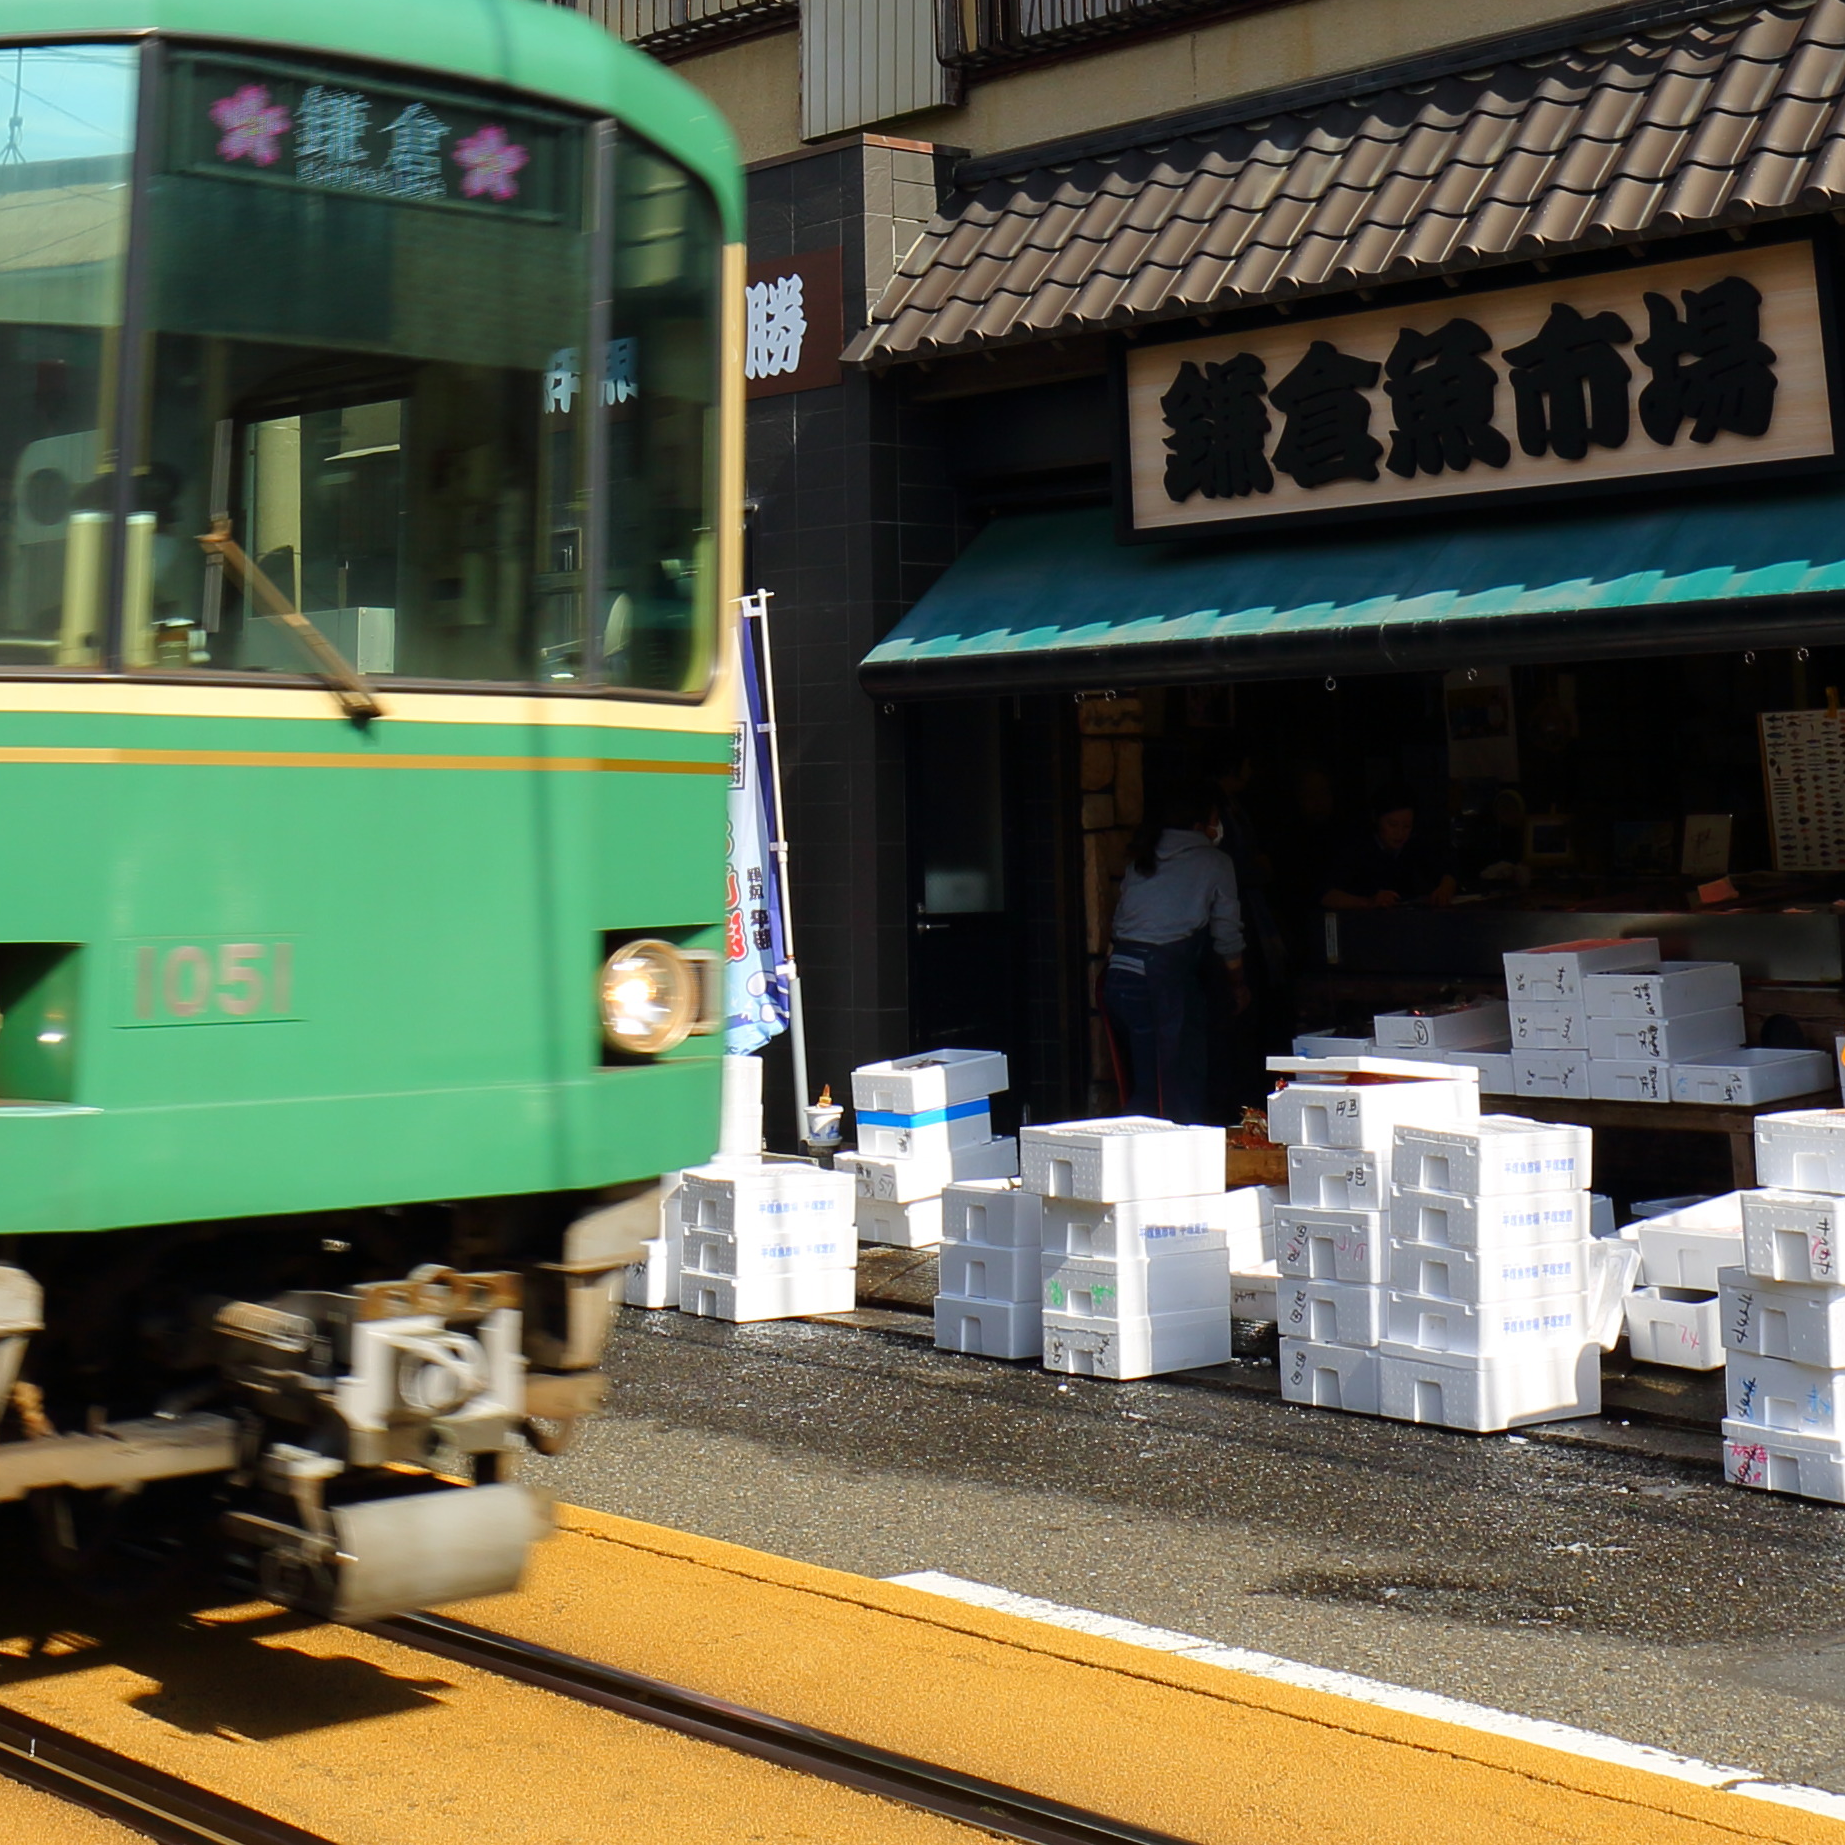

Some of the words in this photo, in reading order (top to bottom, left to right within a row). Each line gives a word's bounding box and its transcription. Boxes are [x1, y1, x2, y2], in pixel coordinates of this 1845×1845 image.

[1160, 275, 1778, 503] 鎌倉魚市場
[134, 943, 295, 1020] 1051
